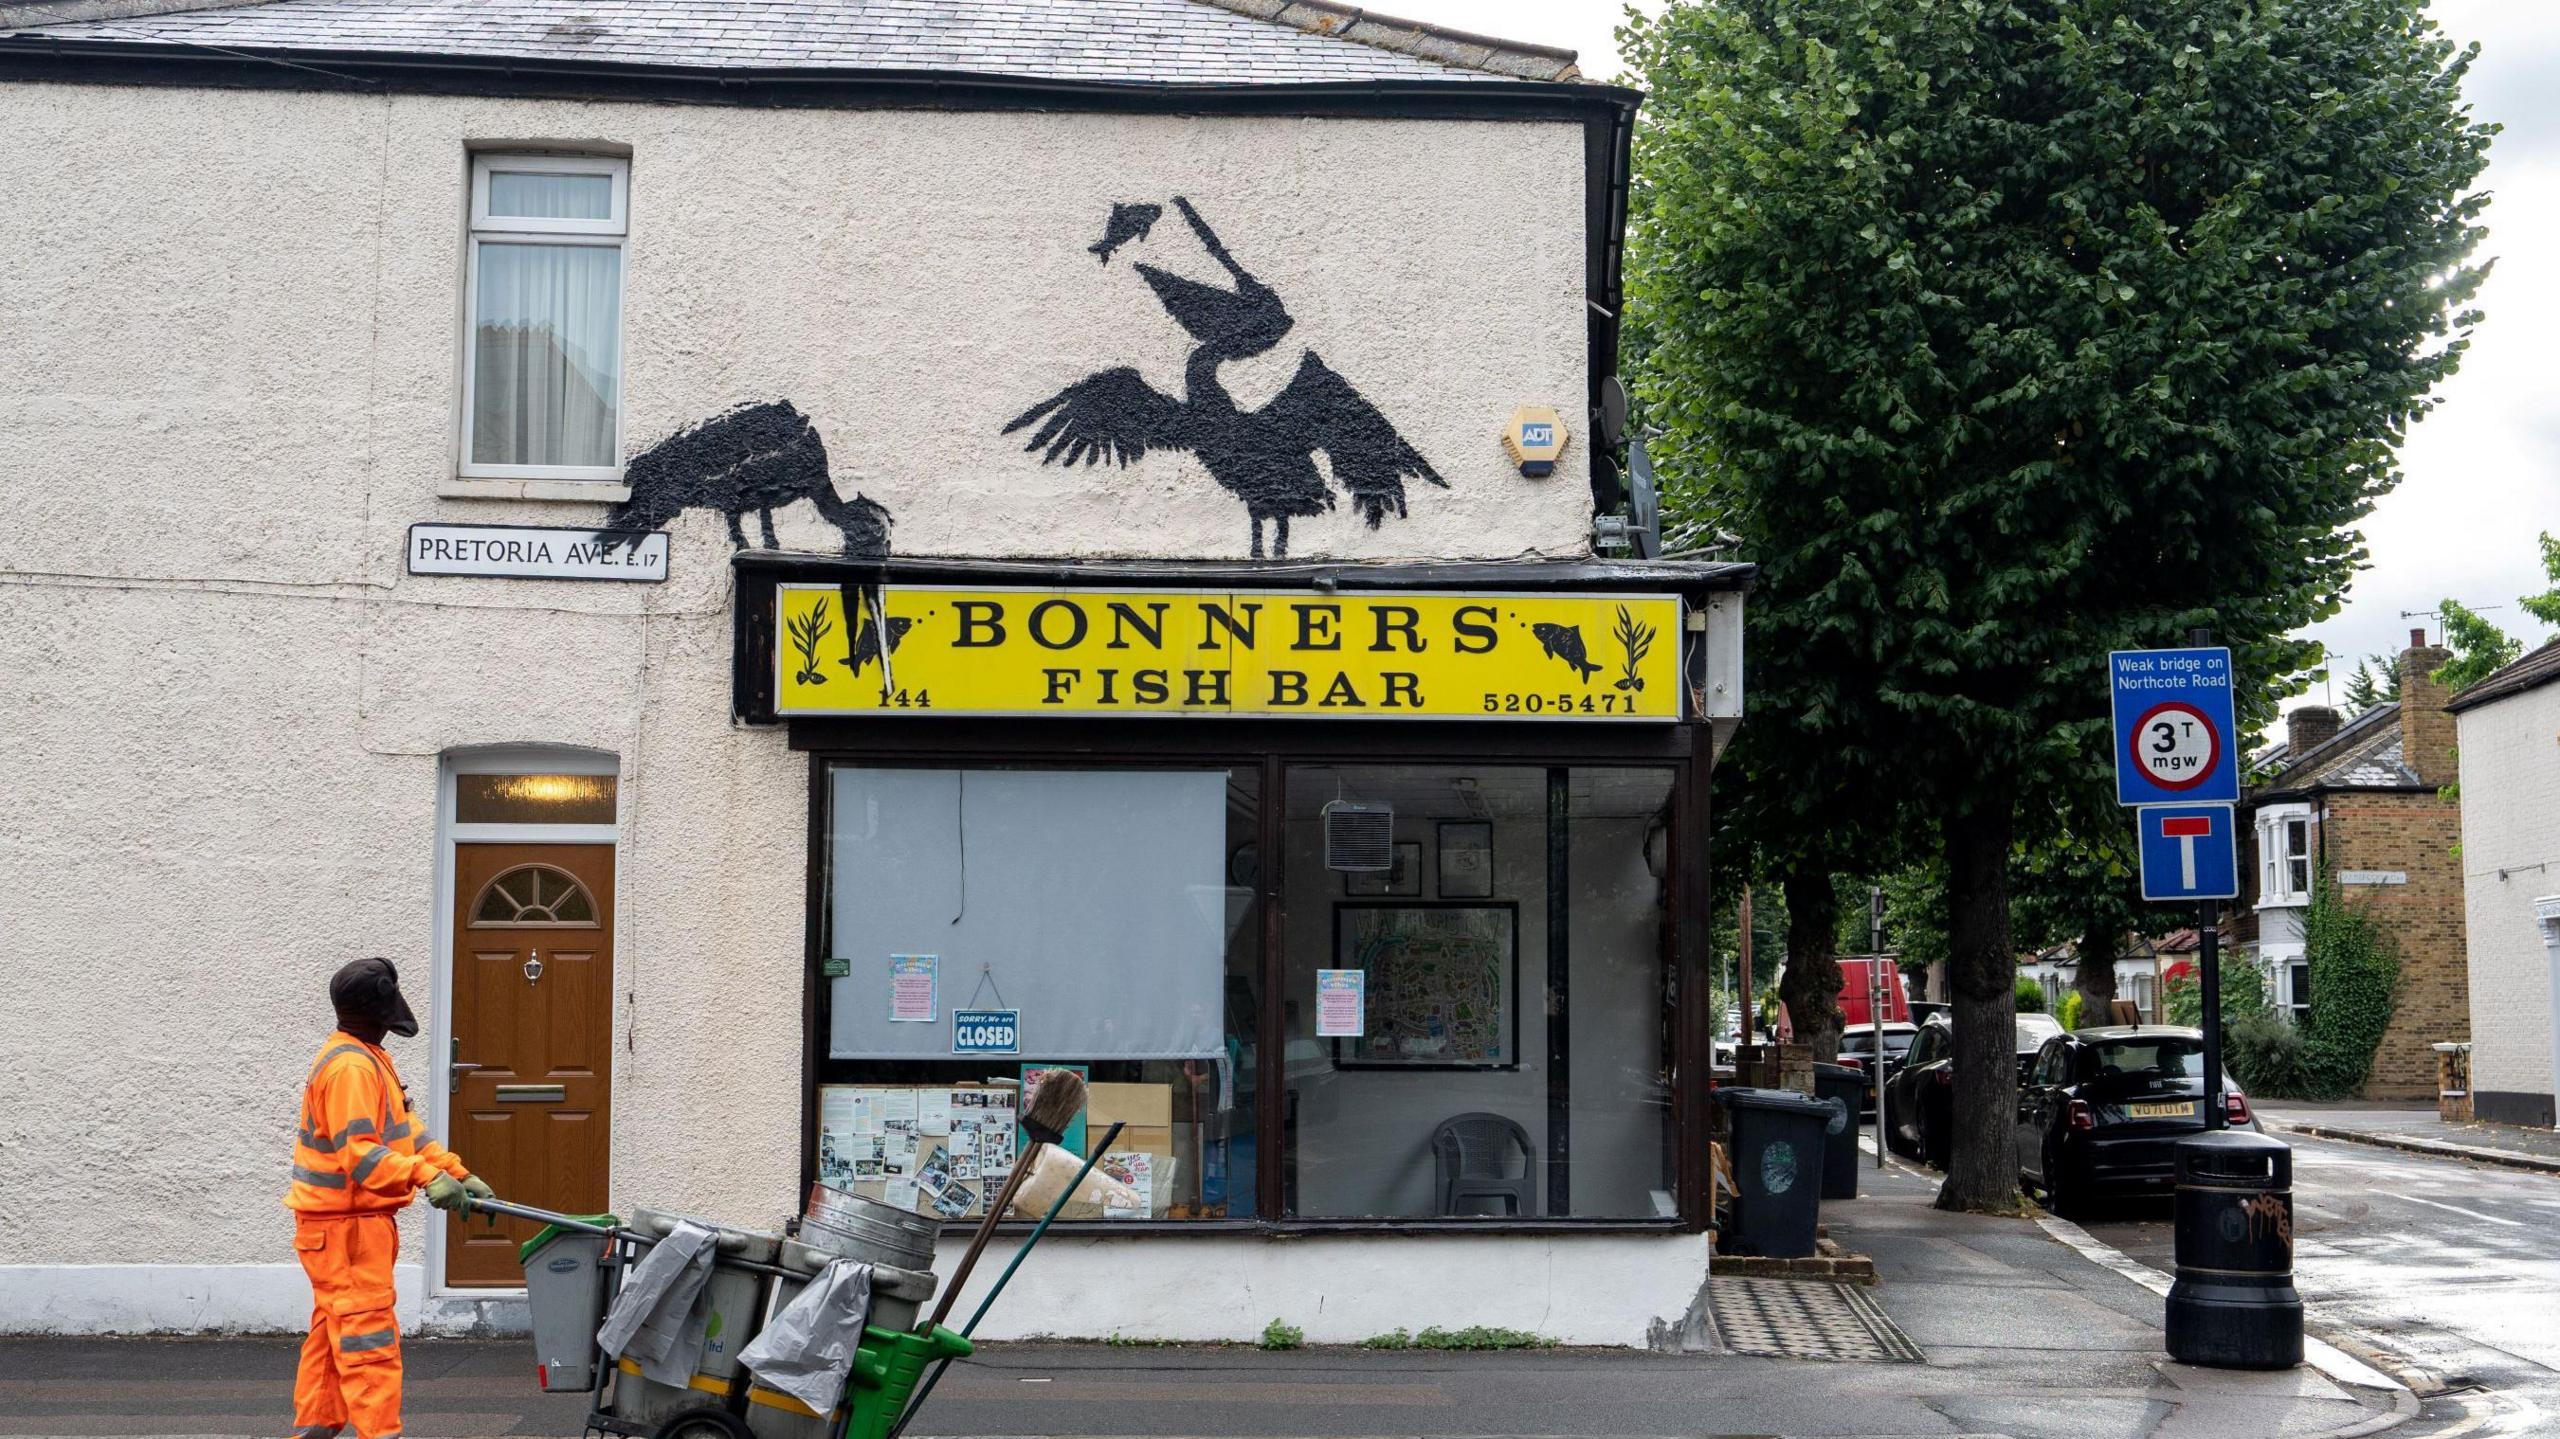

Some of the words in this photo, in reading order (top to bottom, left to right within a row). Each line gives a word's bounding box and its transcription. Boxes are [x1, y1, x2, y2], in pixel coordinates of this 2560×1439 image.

[1523, 428, 1552, 442] ADT
[419, 538, 553, 563] PRETORIA
[951, 599, 1499, 654] BONNERS
[2118, 658, 2154, 672] Weak
[2160, 657, 2201, 672] bridge
[2207, 658, 2223, 669] on
[1042, 668, 1232, 706] FISH
[1267, 670, 1426, 708] BAR
[2118, 675, 2187, 689] Northcote
[2192, 673, 2226, 687] Road
[878, 689, 931, 707] 144
[1483, 694, 1636, 713] 520-5471
[2153, 756, 2197, 770] mgw
[957, 1026, 1014, 1046] CLOSED
[709, 1340, 724, 1353] ltd
